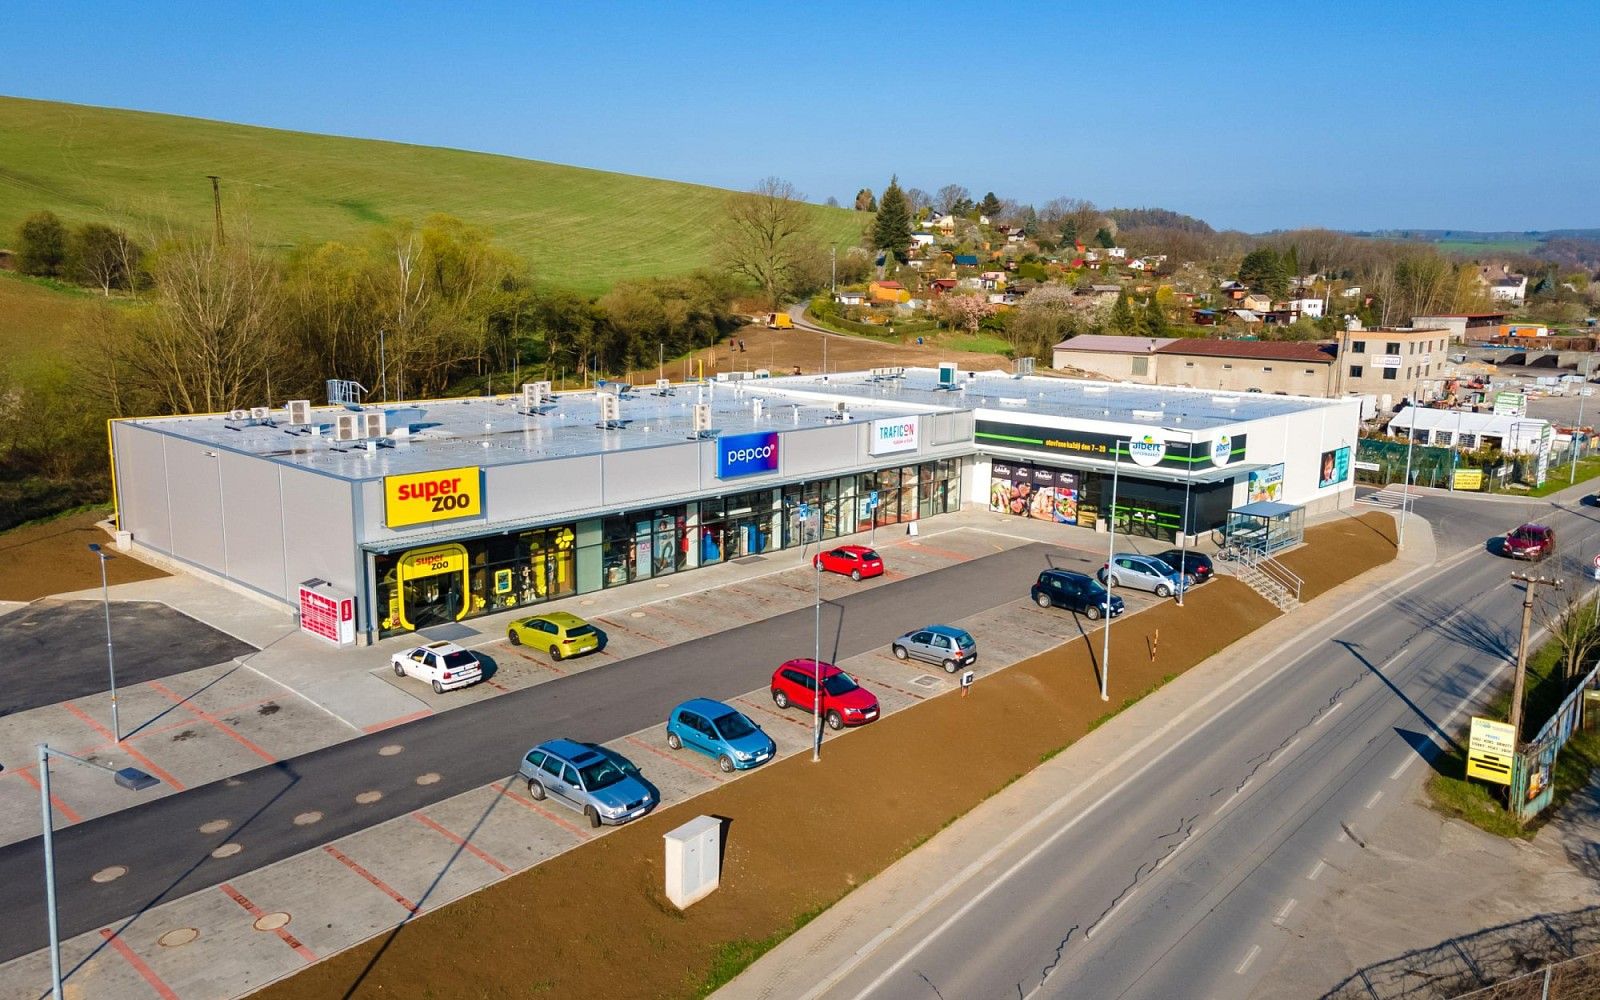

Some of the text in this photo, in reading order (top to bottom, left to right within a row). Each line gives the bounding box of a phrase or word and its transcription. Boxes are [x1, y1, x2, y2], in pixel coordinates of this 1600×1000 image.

[880, 424, 914, 439] TRAFICON
[728, 445, 771, 465] pepco
[398, 477, 461, 501] super
[431, 493, 470, 513] zoo
[416, 554, 443, 566] super
[431, 561, 449, 570] zoo
